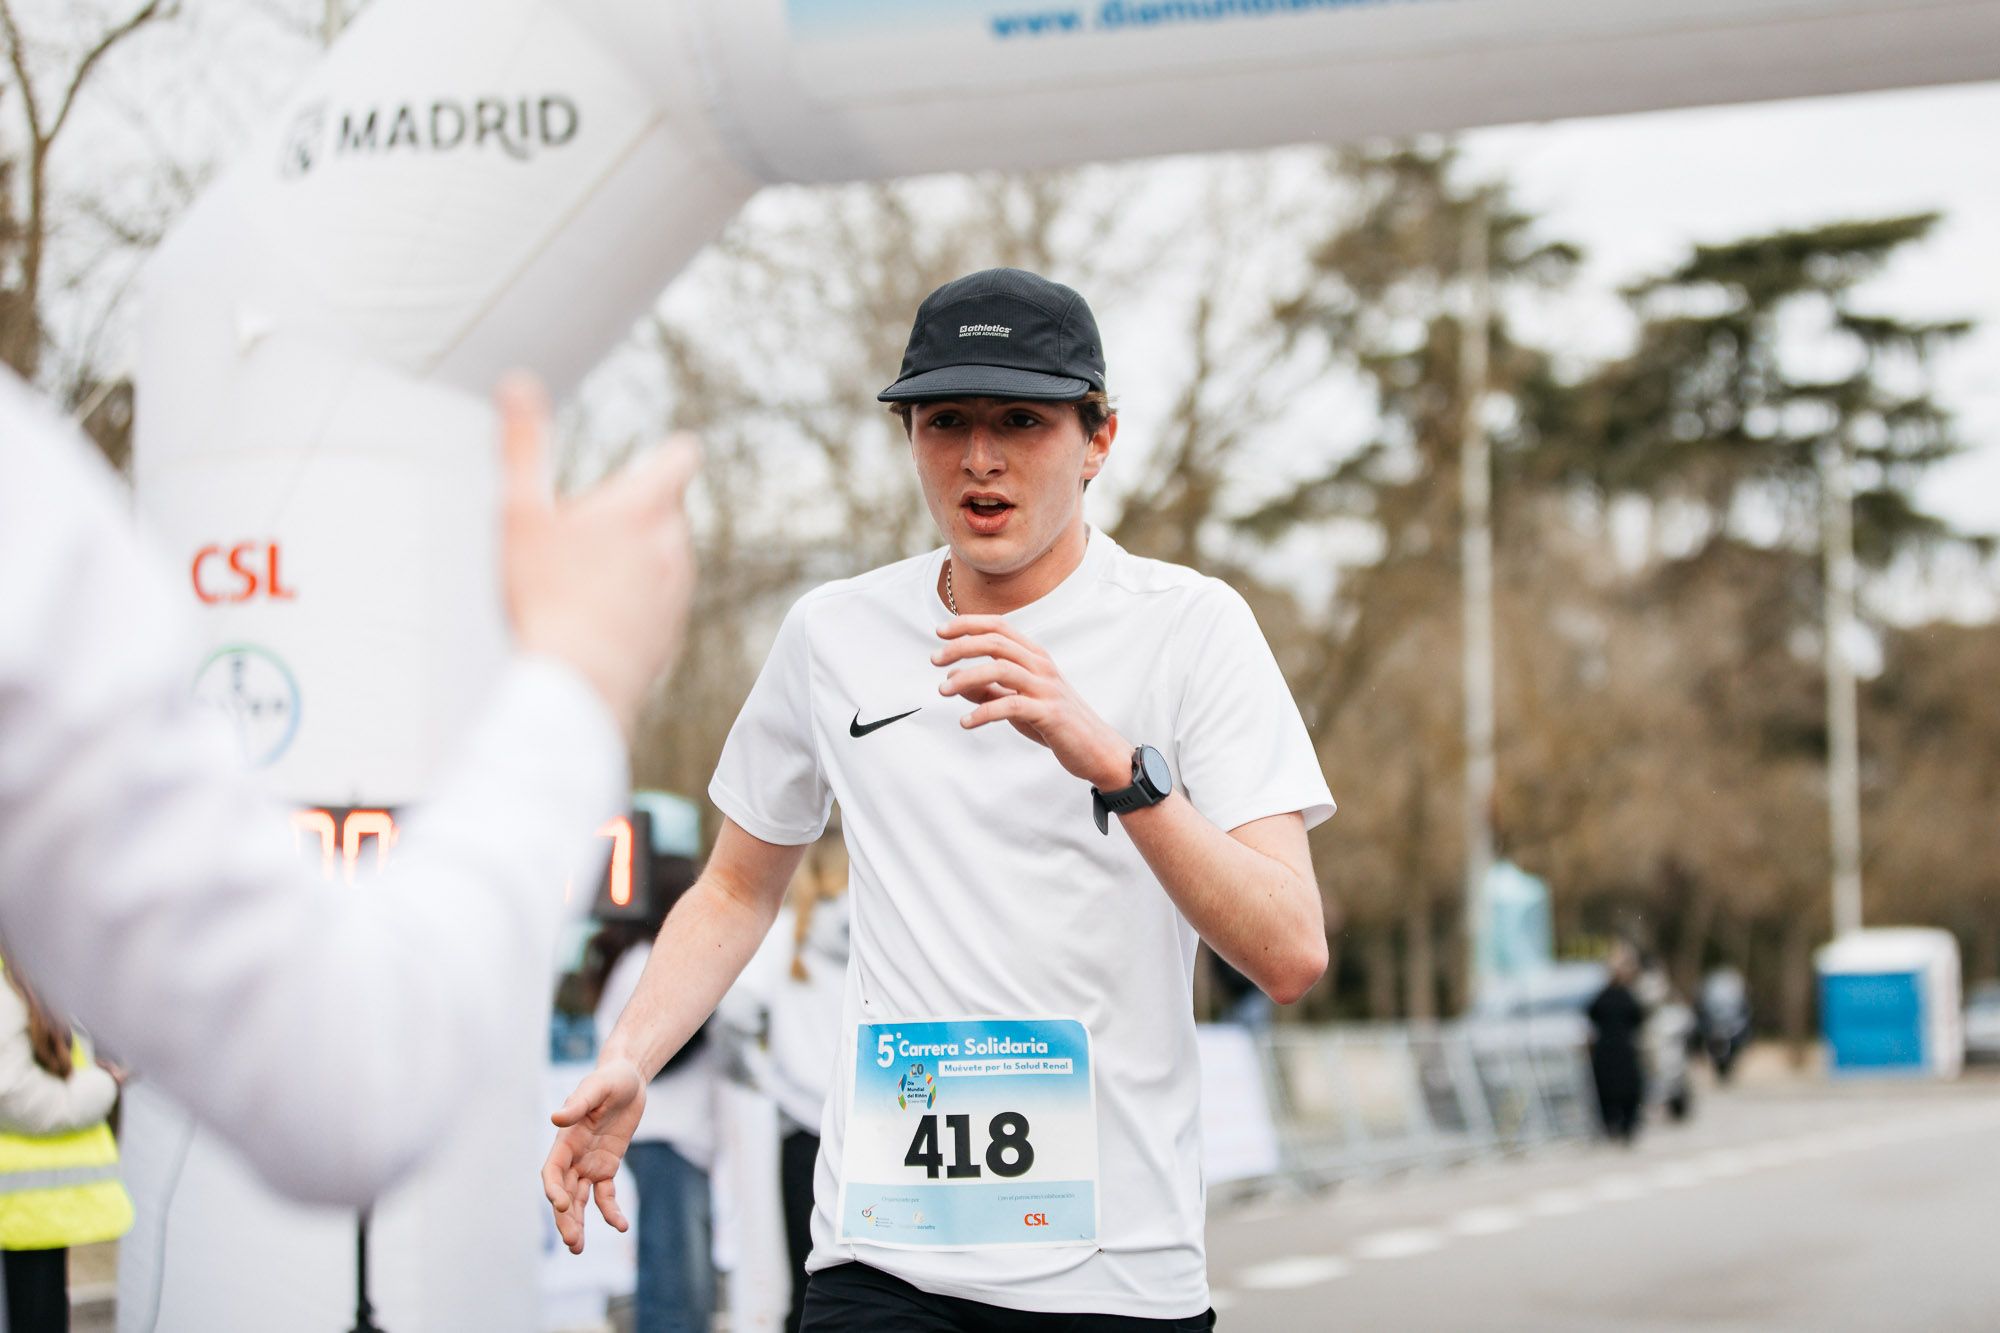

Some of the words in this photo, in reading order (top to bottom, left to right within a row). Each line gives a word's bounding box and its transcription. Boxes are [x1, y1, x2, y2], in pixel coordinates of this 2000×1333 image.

[335, 94, 581, 161] MADRID
[967, 324, 1010, 333] athletics
[191, 540, 296, 604] CSL
[899, 1040, 959, 1057] Carrera
[964, 1036, 1048, 1055] Solidaria
[944, 1064, 982, 1072] Muévete
[986, 1065, 1000, 1073] por
[1003, 1062, 1012, 1070] la
[1014, 1062, 1040, 1070] Salud
[1043, 1062, 1069, 1070] Renal
[904, 1111, 1035, 1179] 418
[1024, 1213, 1049, 1226] CSL
